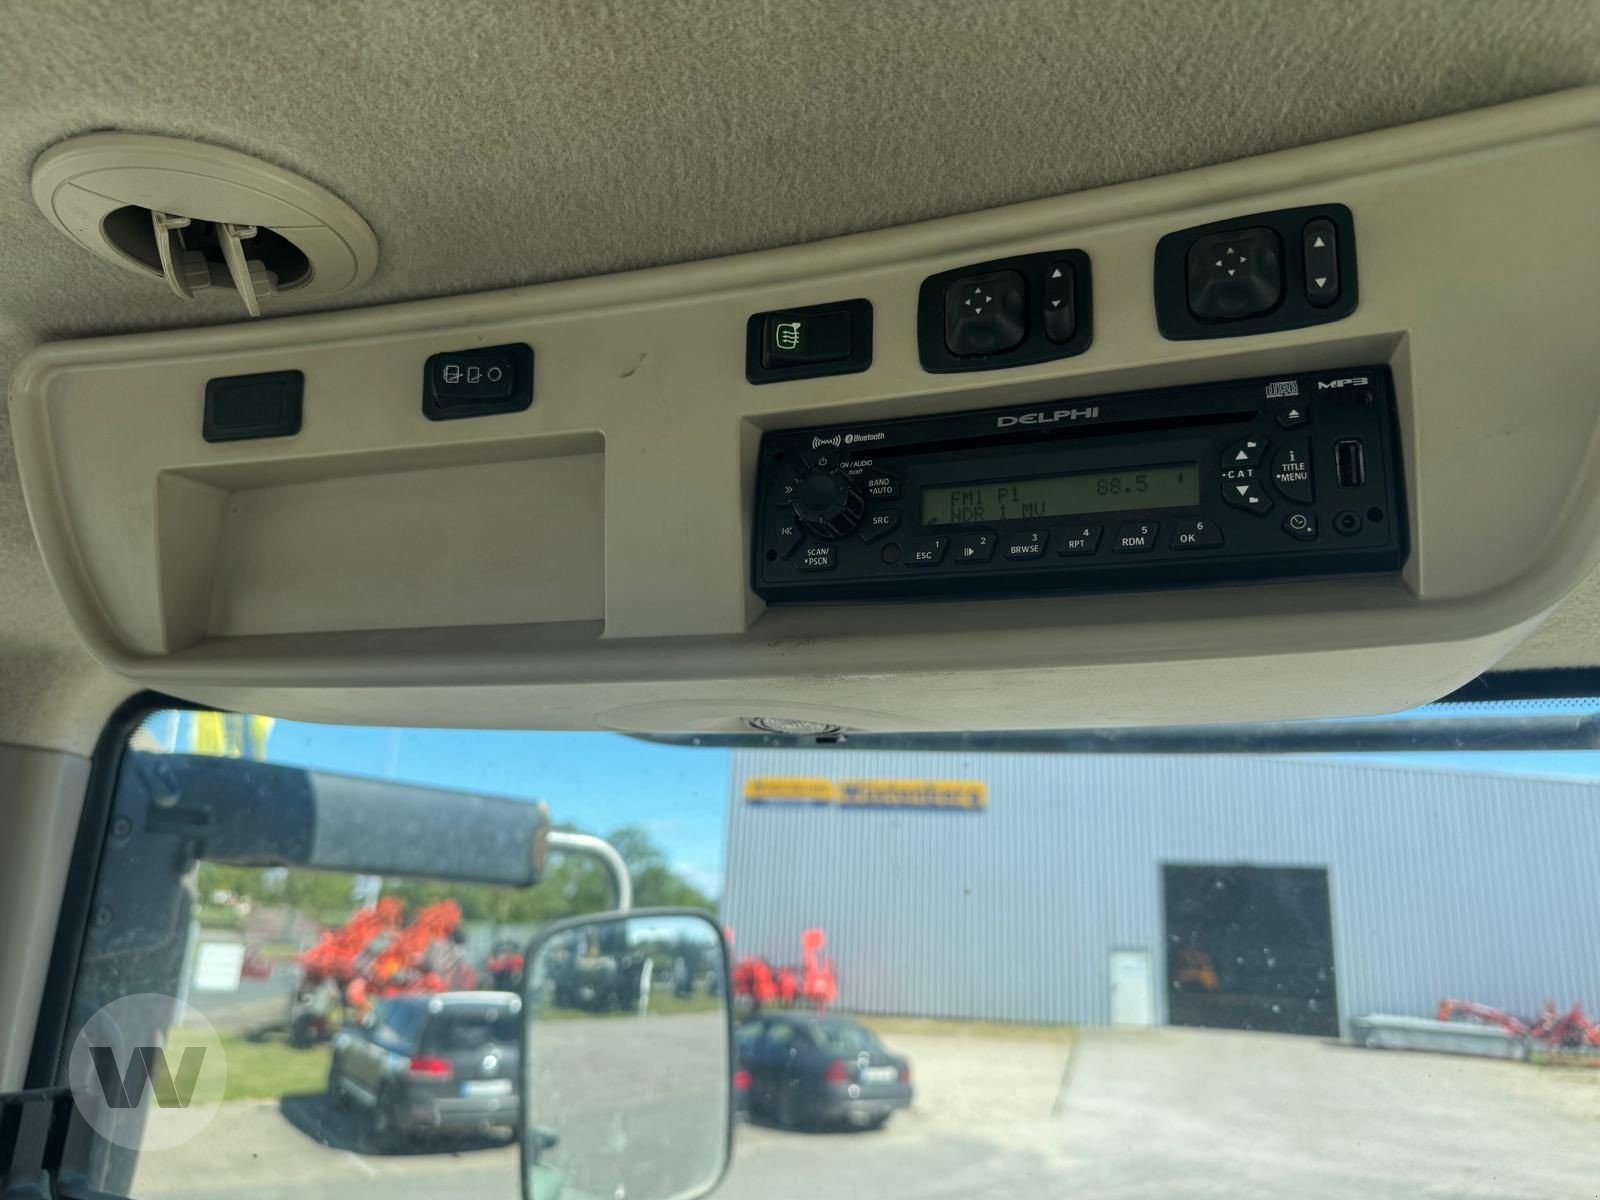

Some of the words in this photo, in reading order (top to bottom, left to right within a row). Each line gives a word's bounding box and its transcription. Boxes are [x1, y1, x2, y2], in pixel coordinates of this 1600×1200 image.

[1317, 378, 1369, 390] MP3
[997, 407, 1099, 428] DELPHI
[854, 432, 885, 443] Bluetooth
[1282, 462, 1305, 472] TITLE
[869, 479, 890, 487] BAND
[951, 490, 982, 507] FM1
[998, 486, 1019, 504] P1
[1096, 475, 1147, 496] 88.5
[951, 506, 985, 523] NDR
[873, 517, 889, 525] SRC
[1141, 526, 1147, 534] 5
[1197, 522, 1203, 531] 6
[1082, 529, 1089, 537] 4
[980, 537, 987, 545] 2
[1032, 534, 1038, 542] 3
[1122, 537, 1144, 546] RDM
[1179, 534, 1195, 543] OK
[935, 540, 940, 549] 1
[1068, 540, 1085, 549] RPT
[1011, 545, 1040, 554] BRWSE
[916, 552, 932, 560] ESC
